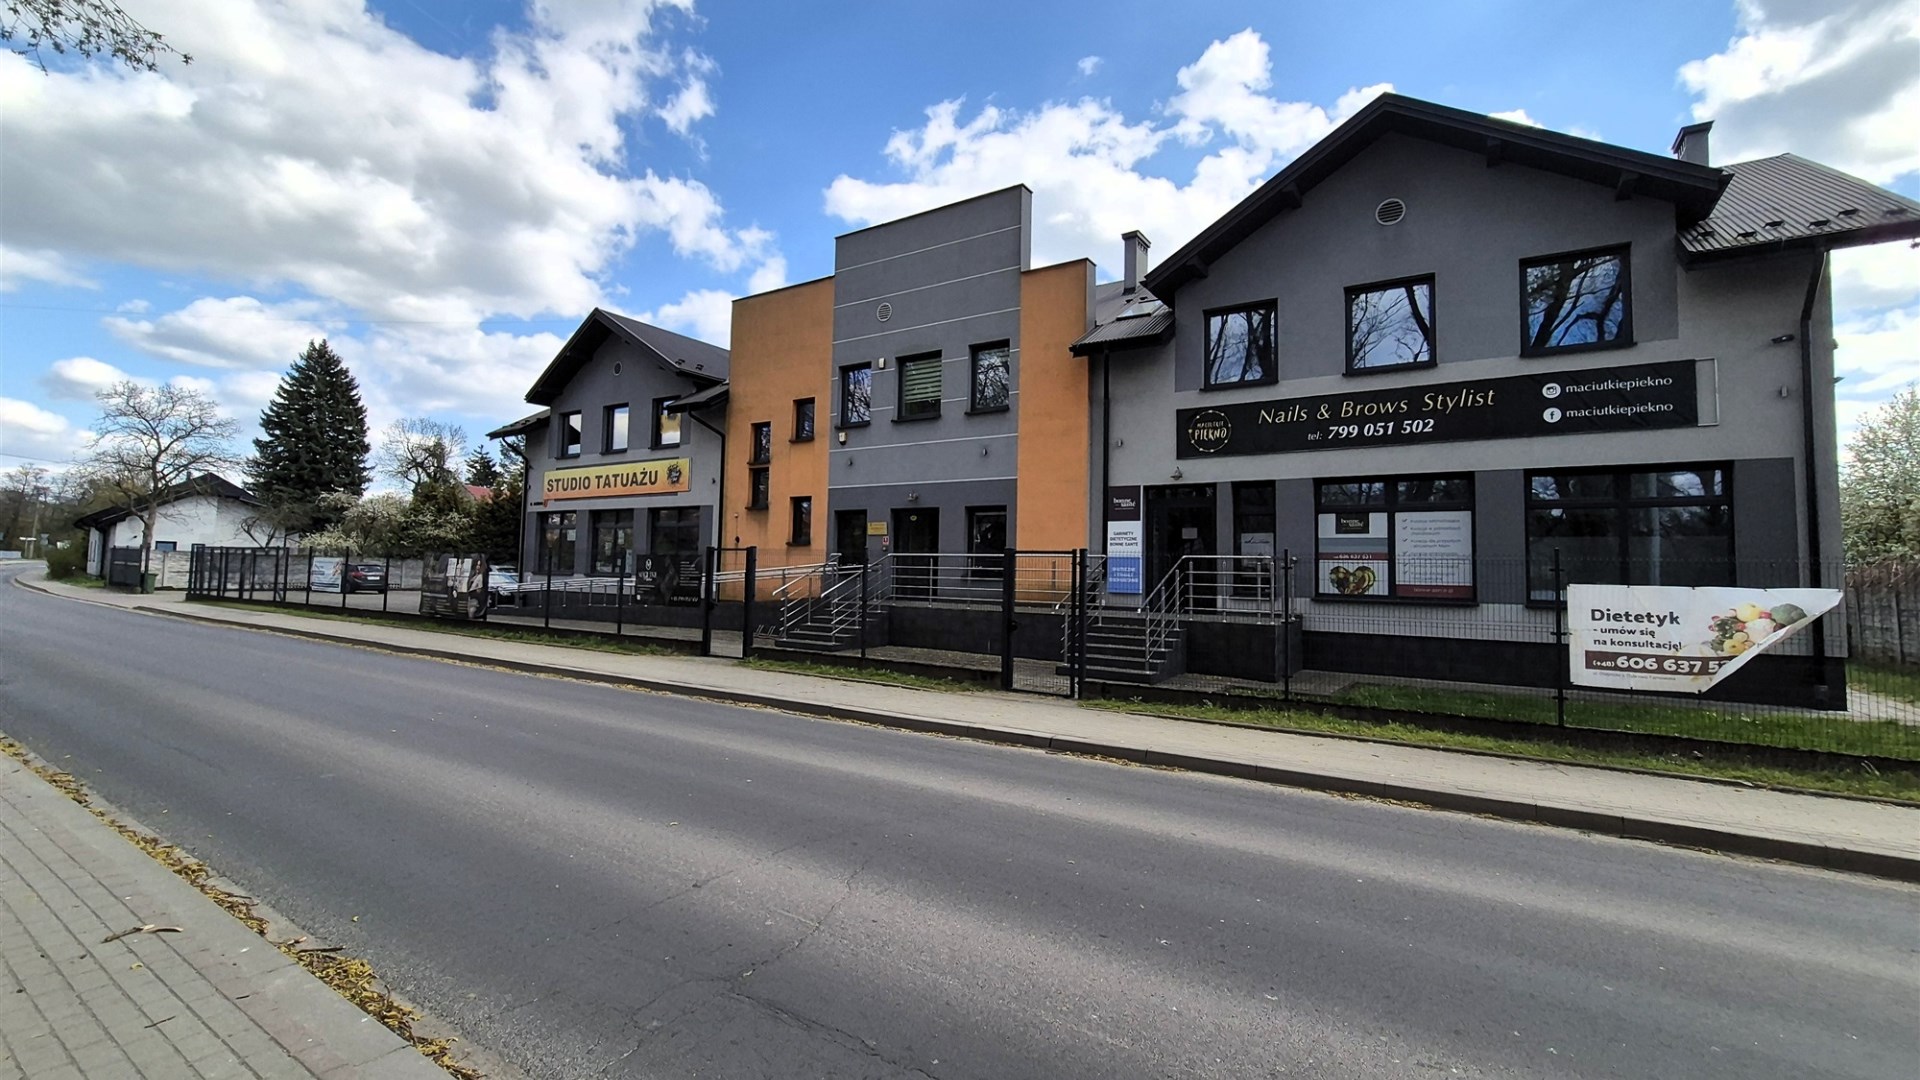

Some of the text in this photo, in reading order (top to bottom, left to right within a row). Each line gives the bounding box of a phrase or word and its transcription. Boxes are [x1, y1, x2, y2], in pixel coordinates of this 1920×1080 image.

[1565, 376, 1673, 393] maciutkiepiekno
[1258, 388, 1495, 425] Nails & Brows Stylist
[1566, 402, 1673, 417] maciutkiepiekno
[1307, 418, 1435, 441] tel: 799 051 502
[546, 467, 658, 493] STUDIO TATUAŻU
[1590, 608, 1681, 627] Dietetyk
[1600, 625, 1637, 636] umów
[1639, 627, 1656, 638] się
[1610, 638, 1682, 652] konsultację!
[1592, 659, 1615, 668] (+48)
[1616, 655, 1658, 671] 606
[1663, 658, 1702, 673] 637
